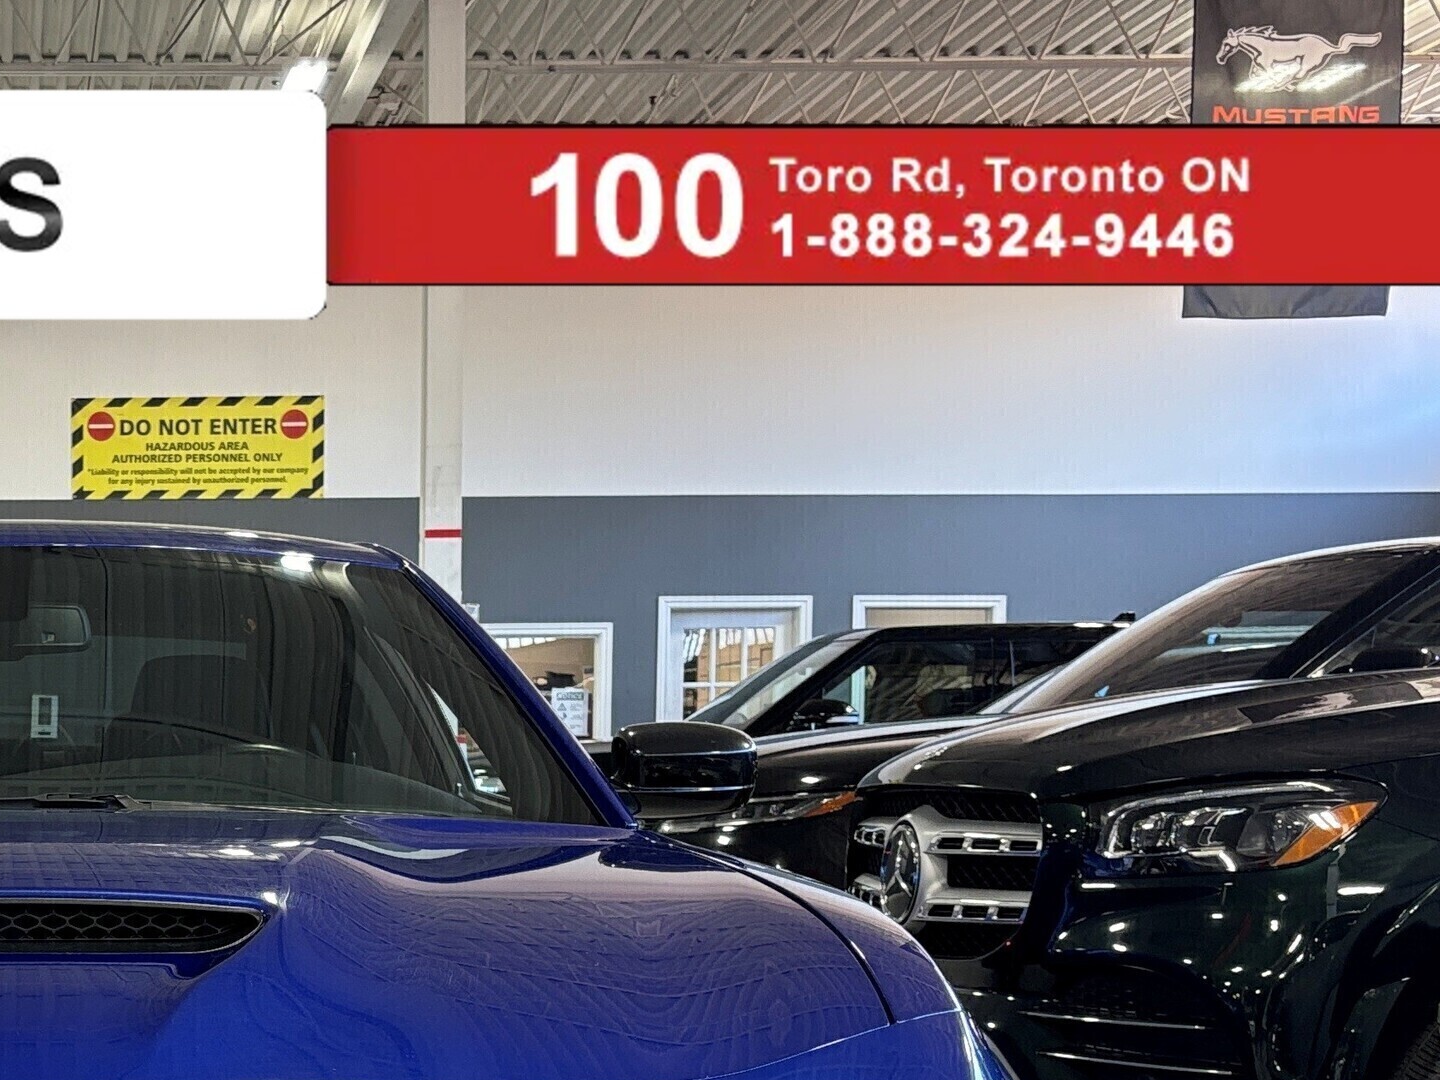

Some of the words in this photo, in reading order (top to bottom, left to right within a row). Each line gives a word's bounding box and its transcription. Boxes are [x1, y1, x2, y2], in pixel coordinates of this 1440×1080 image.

[1212, 105, 1381, 124] MUSTANG
[119, 419, 151, 436] DO
[159, 418, 203, 436] NOT
[209, 418, 277, 435] ENTER
[145, 442, 216, 451] HAZARDOUS
[218, 441, 249, 450] AREA
[111, 454, 182, 463] AUTHORIZED
[185, 453, 250, 463] PERSONNEL
[253, 453, 283, 462] ONLY
[130, 468, 178, 476] responsibility
[180, 467, 193, 475] will
[219, 467, 251, 475] accepted
[252, 467, 261, 475] by
[276, 467, 309, 475] company
[120, 478, 133, 486] any
[135, 477, 156, 486] injury
[192, 477, 201, 485] by
[202, 476, 250, 484] unauthorized
